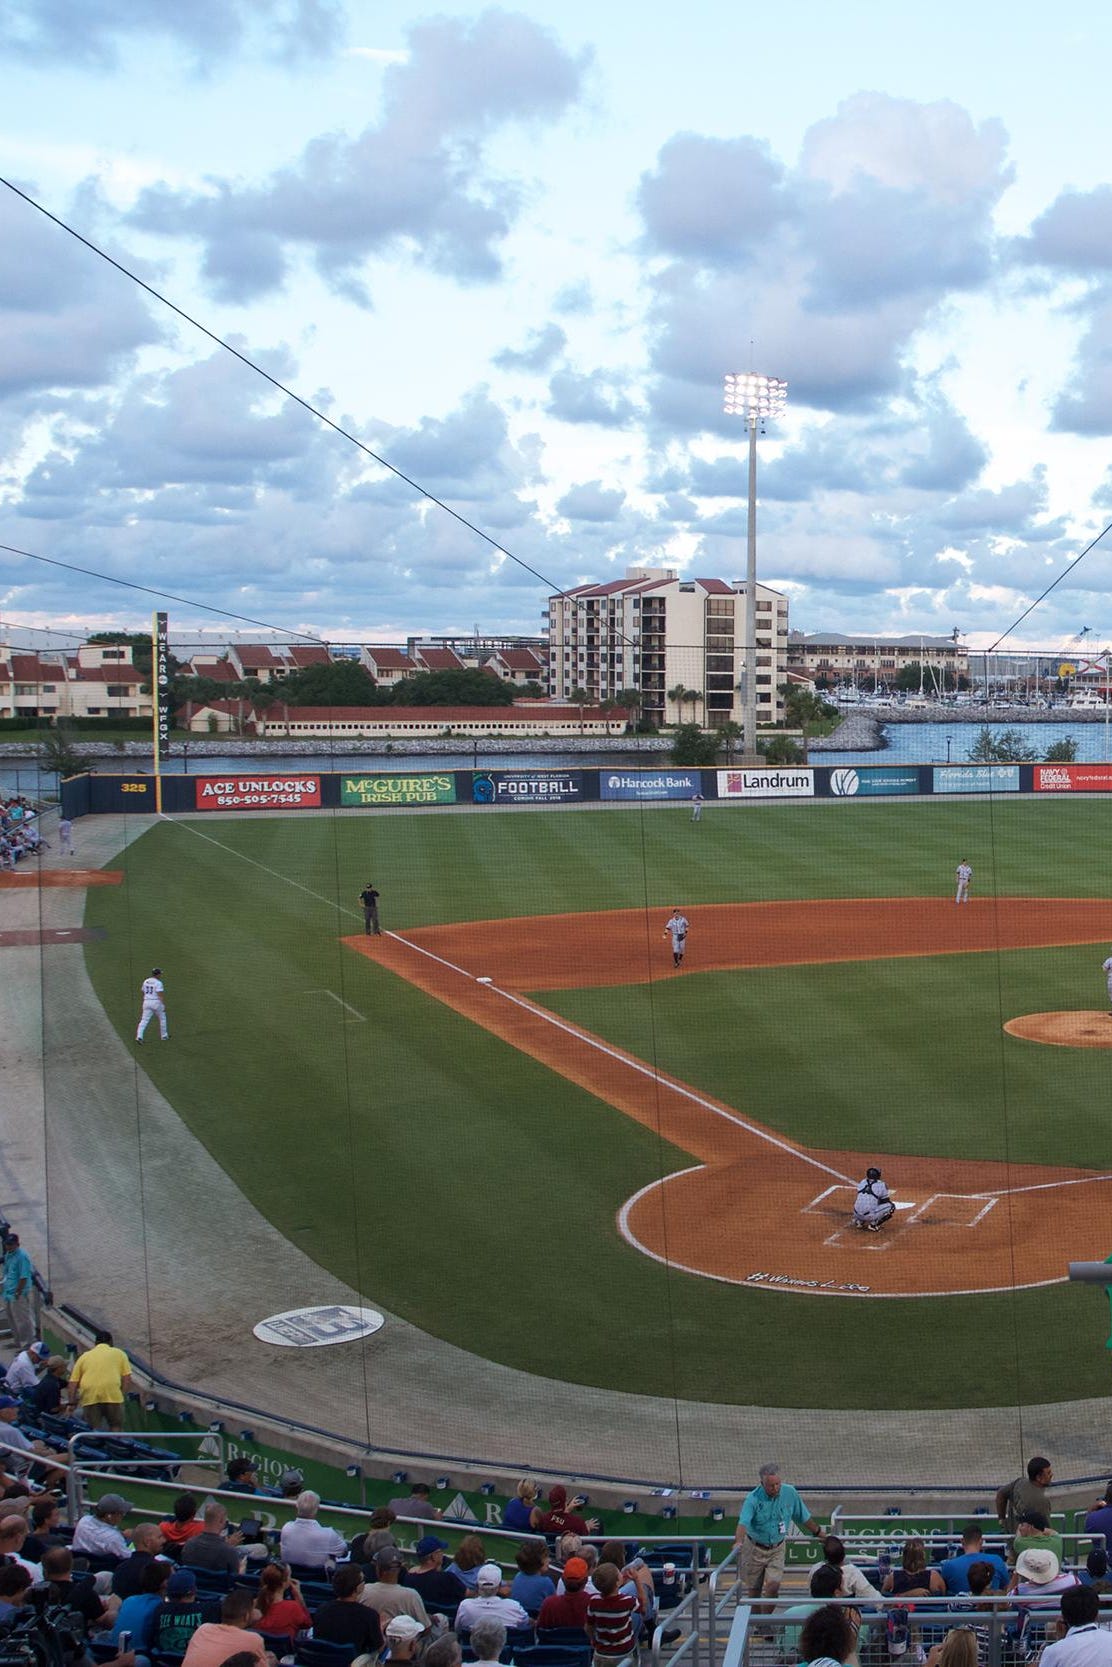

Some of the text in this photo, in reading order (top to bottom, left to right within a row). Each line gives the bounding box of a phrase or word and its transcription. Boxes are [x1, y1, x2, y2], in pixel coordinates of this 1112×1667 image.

[621, 775, 692, 789] Hancock Bank
[743, 773, 809, 789] Landrum
[1040, 774, 1071, 782] FEDERAL
[121, 783, 147, 793] 325
[202, 780, 317, 796] ACE UNLOCKS
[498, 780, 579, 794] FOOTBALL
[217, 793, 301, 806] 850-505-7545
[361, 791, 437, 803] IRISH PUB
[551, 1514, 565, 1525] FSU
